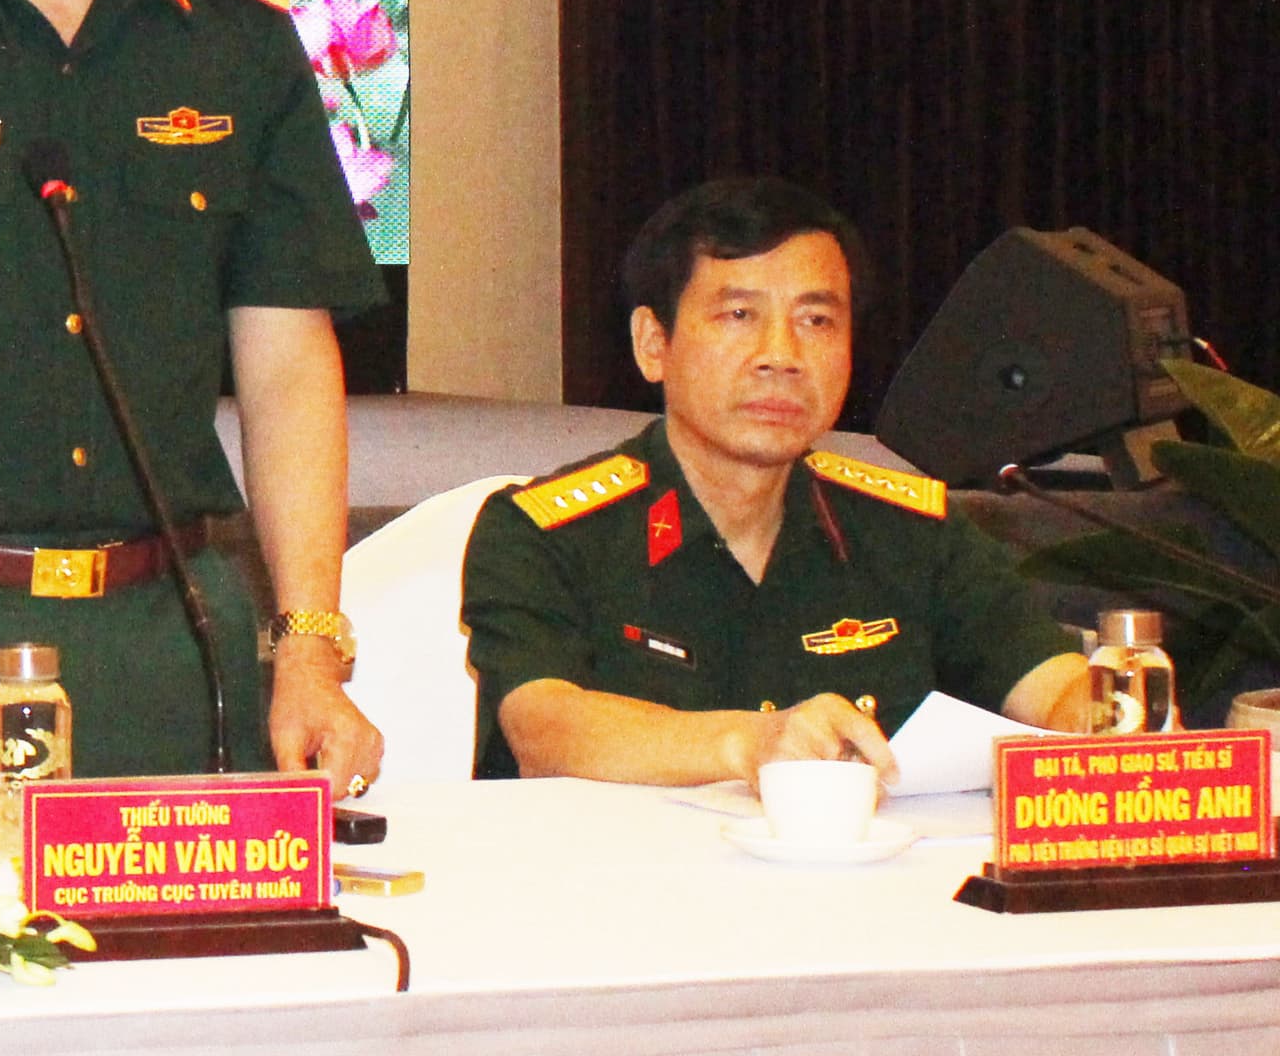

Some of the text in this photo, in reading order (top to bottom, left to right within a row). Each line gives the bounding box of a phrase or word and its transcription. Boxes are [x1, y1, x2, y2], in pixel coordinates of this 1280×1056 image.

[120, 800, 170, 827] THIẾU
[1015, 775, 1252, 829] DƯƠNG HỒNG ANH
[43, 827, 309, 877] NGUYỄN VĂN ĐỨC
[54, 876, 301, 907] CỤC TRƯỞNG CỤC TUYÊN HUẤN
